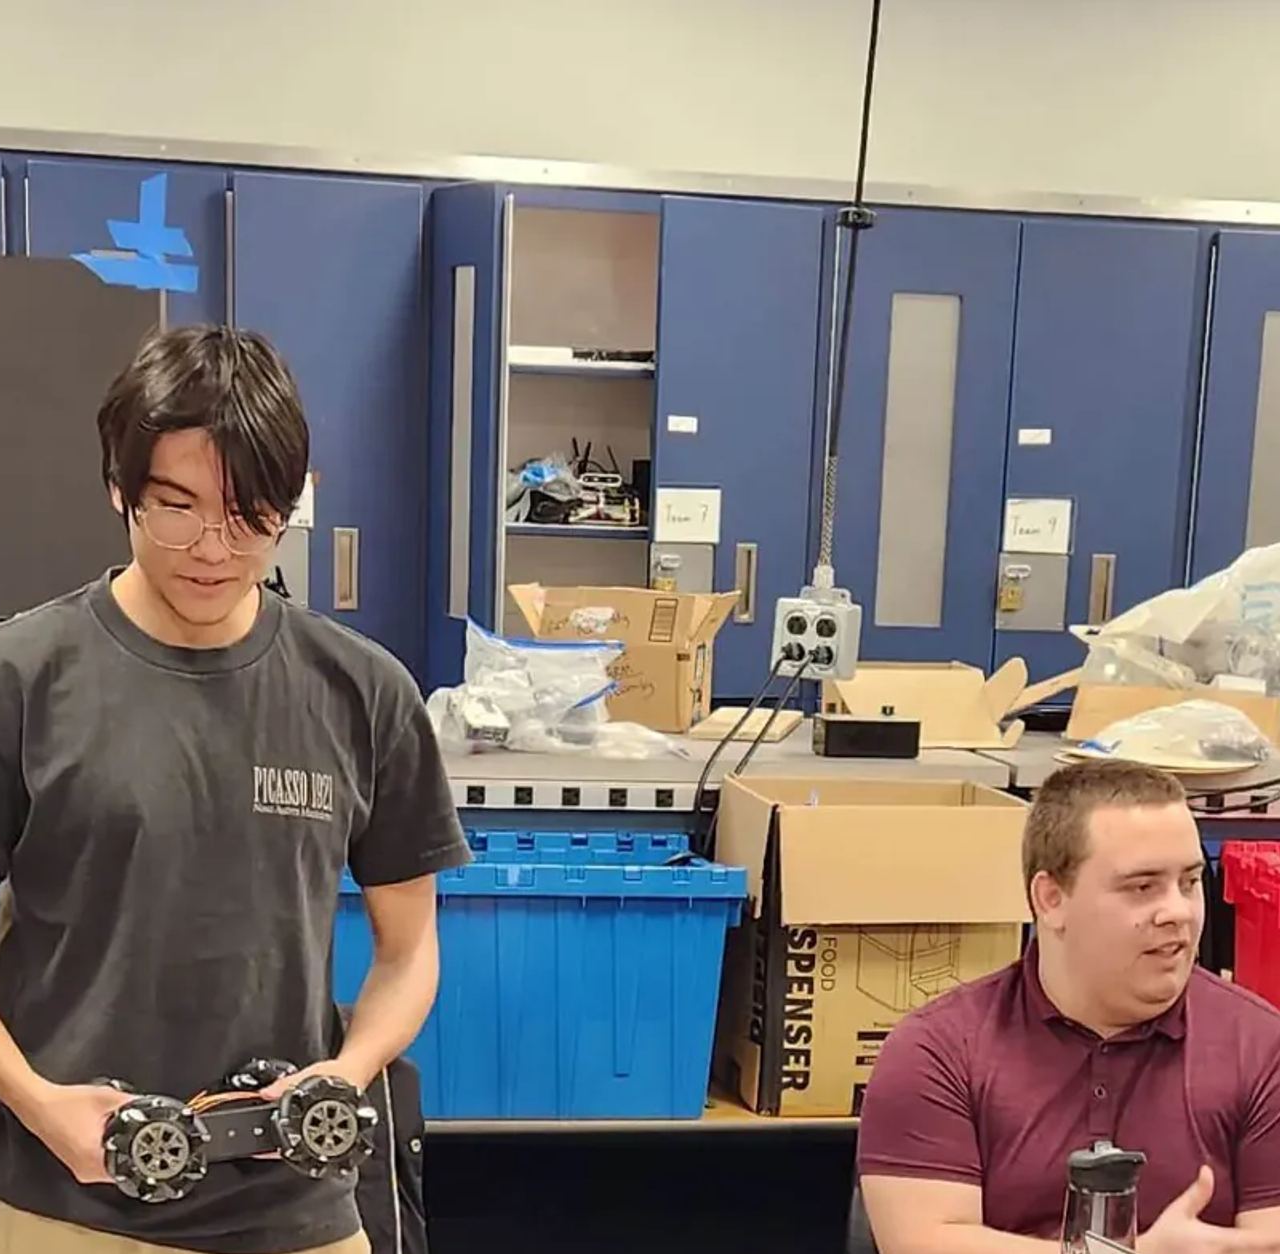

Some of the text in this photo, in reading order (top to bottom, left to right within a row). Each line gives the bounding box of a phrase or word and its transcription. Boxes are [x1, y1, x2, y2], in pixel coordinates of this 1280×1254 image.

[253, 765, 308, 806] PICASSO
[821, 937, 837, 992] FOOD
[782, 927, 818, 1092] SPENSER
